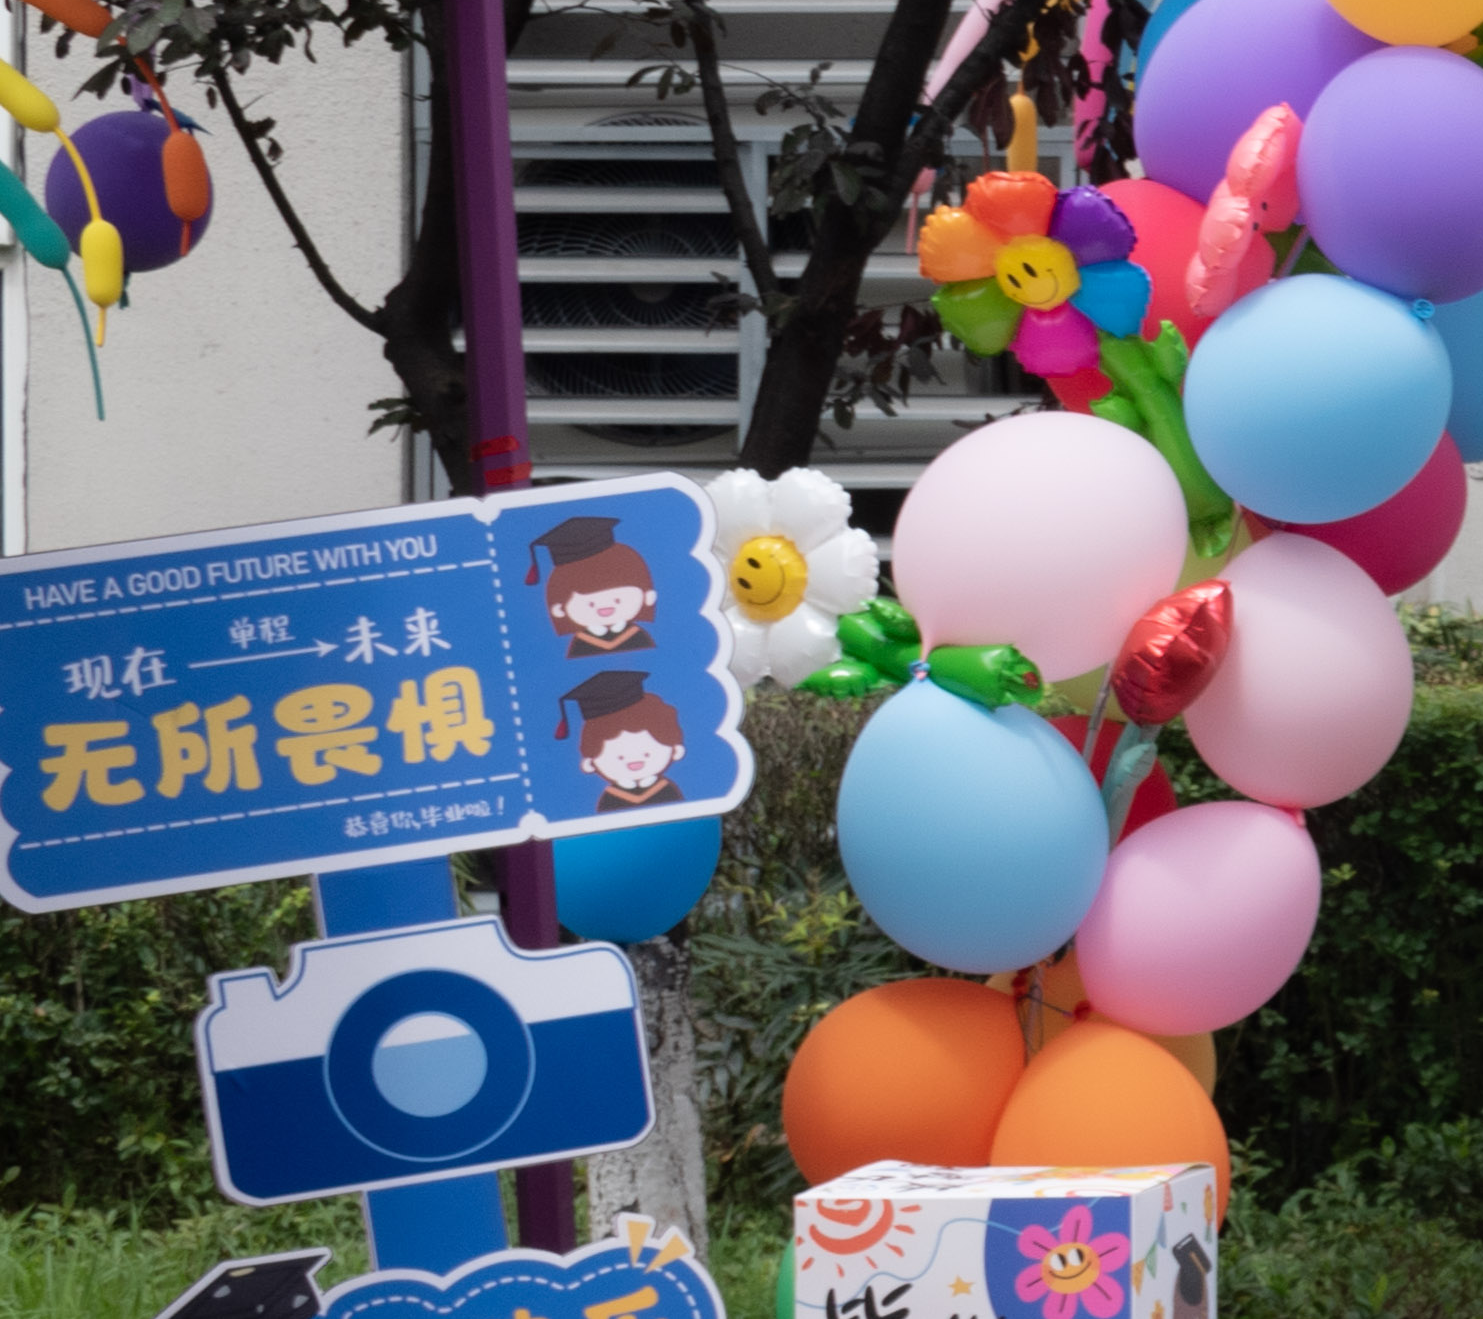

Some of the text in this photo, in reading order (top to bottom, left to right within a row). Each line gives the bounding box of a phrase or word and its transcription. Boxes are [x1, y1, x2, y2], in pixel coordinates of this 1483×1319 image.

[24, 534, 438, 611] HAVE A GOOD FUTURE WITH YOU
[63, 606, 453, 701] 现在 单程 未来
[40, 666, 495, 813] 无所畏惧
